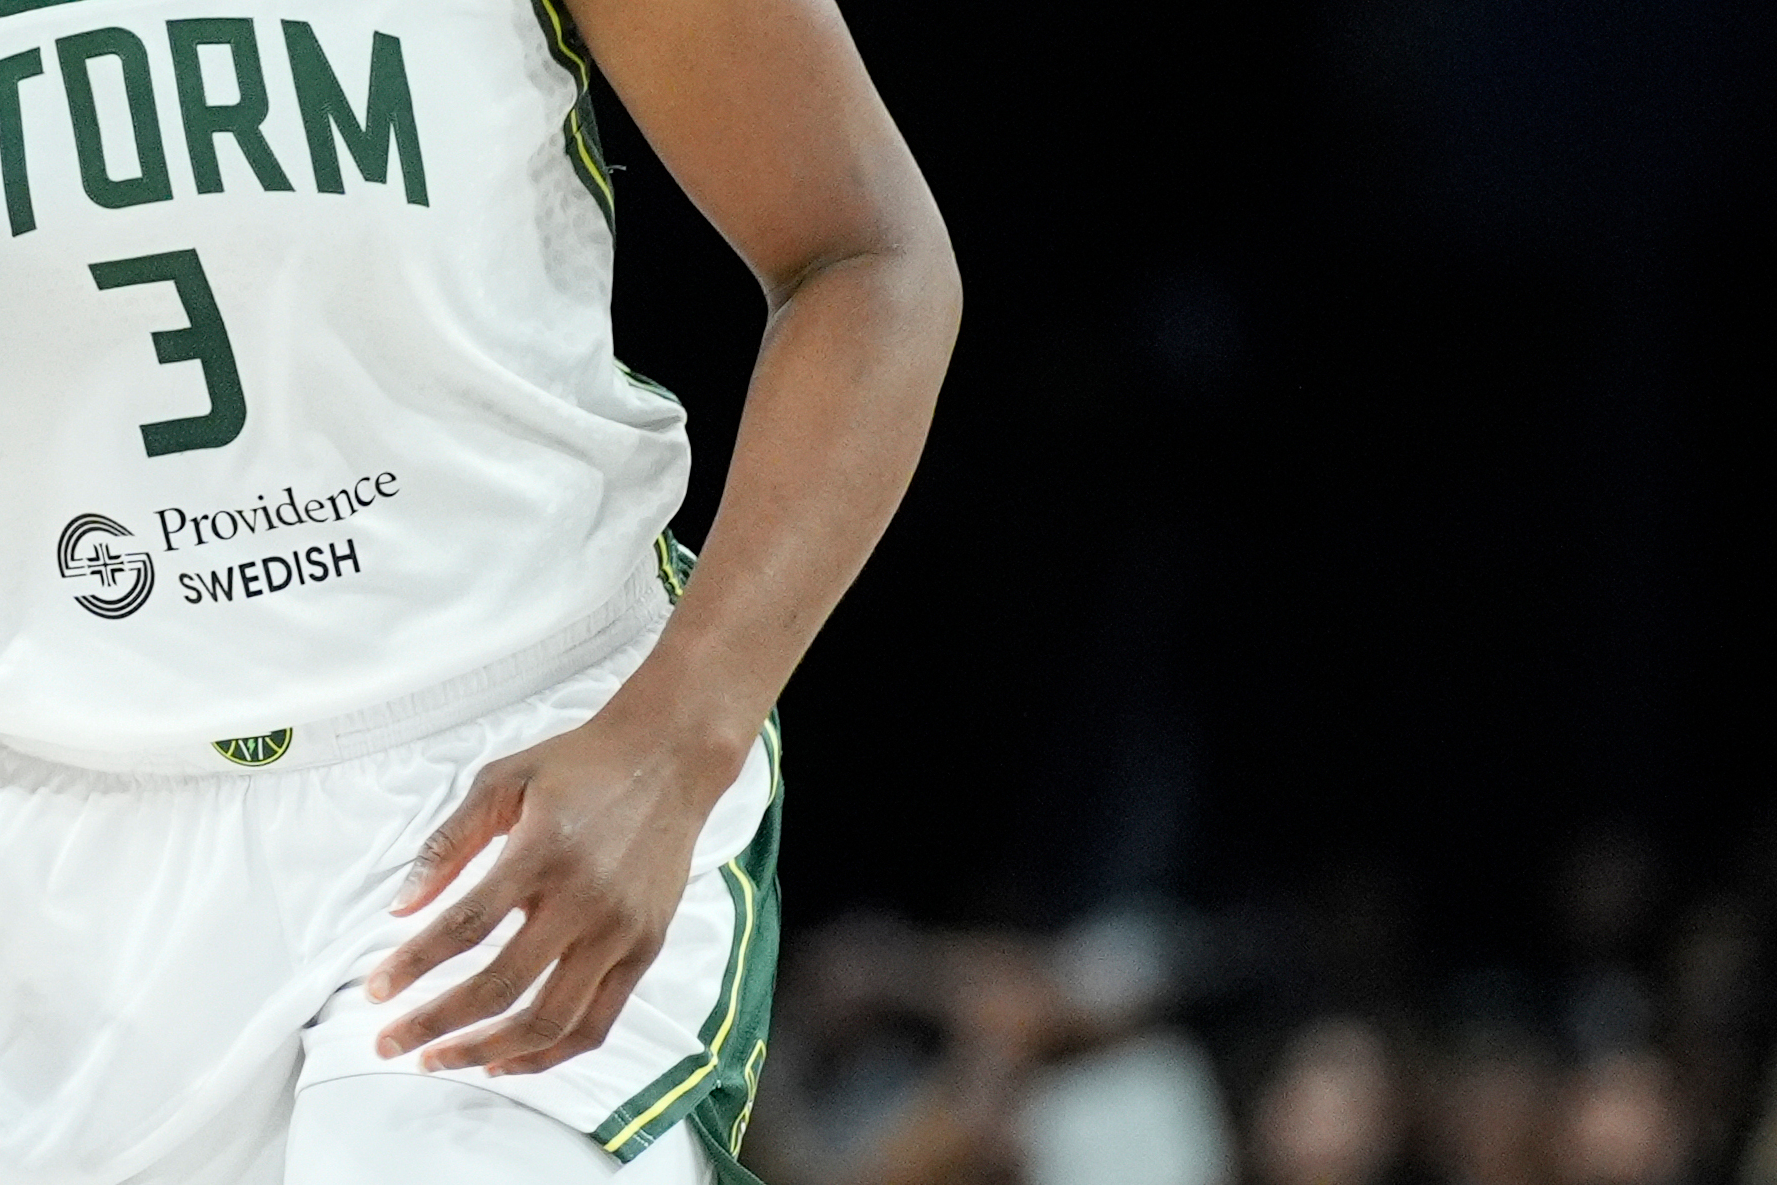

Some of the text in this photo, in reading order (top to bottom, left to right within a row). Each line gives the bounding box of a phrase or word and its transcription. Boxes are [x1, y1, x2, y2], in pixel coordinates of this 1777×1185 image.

[88, 248, 247, 458] 3
[153, 471, 401, 552] Providence
[178, 538, 361, 604] SWEDISH
